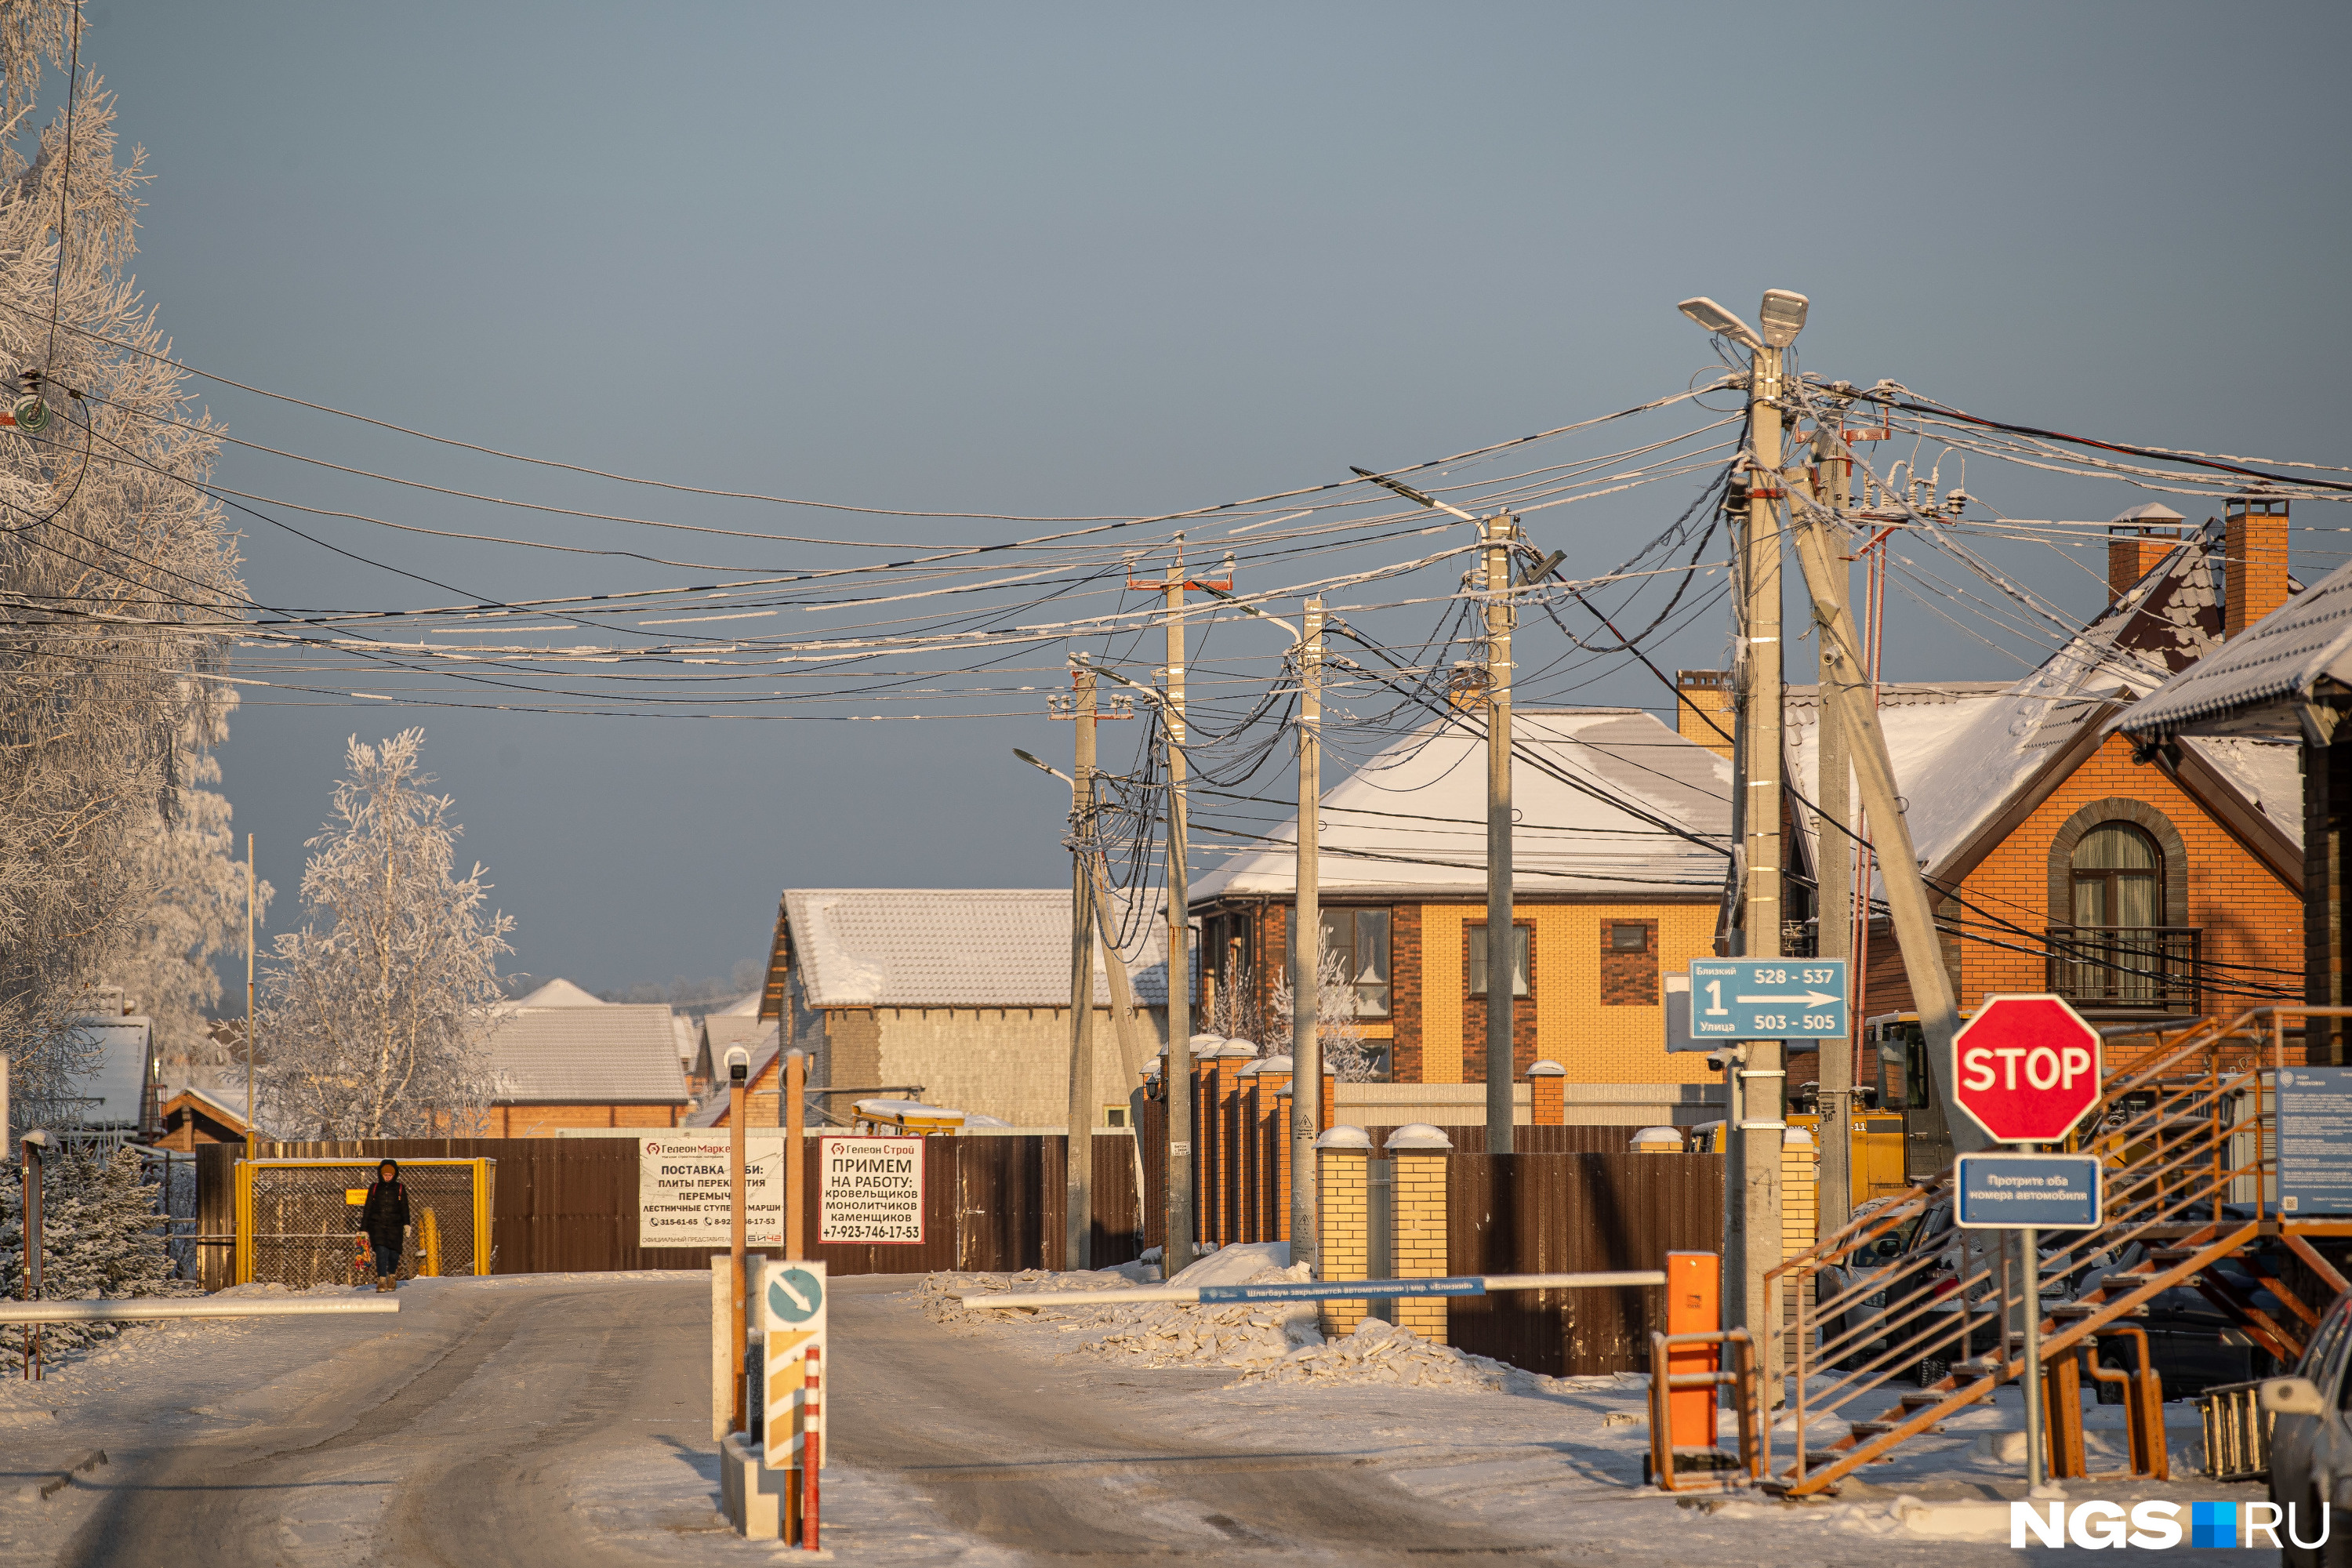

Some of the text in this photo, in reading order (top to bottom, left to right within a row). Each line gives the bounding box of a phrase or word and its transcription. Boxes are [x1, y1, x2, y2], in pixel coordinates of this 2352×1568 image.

[1696, 967, 1737, 975] Близкий
[1755, 969, 1787, 984] 528
[1803, 969, 1835, 984] 537
[1704, 979, 1729, 1016] 1
[1700, 1021, 1736, 1032] Улица
[1754, 1015, 1787, 1029] 503
[1803, 1015, 1835, 1029] 505
[1962, 1047, 2091, 1091] STOP
[1823, 1113, 1833, 1123] 10
[662, 1145, 731, 1154] ГелеонМарке
[847, 1145, 915, 1156] Гелеон Строй
[662, 1165, 724, 1175] ПОСТАВКА
[833, 1159, 912, 1173] ПРИМЕМ
[658, 1179, 765, 1188] ПЛИТЫ ПЕРЕКТИЯ
[831, 1176, 913, 1188] НА РАБОТУ:
[1987, 1174, 2068, 1189] Протрите оба
[678, 1192, 731, 1201] ПЕРЕМЫЧ
[825, 1189, 918, 1200] кровельщиков
[1969, 1189, 2088, 1202] номера автомобиля
[826, 1202, 917, 1210] монолитчиков
[830, 1213, 912, 1224] каменщиков
[823, 1225, 920, 1238] +7-923-746-17-53
[1247, 1288, 1289, 1298] Шлагбаум
[1290, 1287, 1341, 1297] закрывается
[1343, 1285, 1404, 1294] автоматически
[1410, 1284, 1428, 1293] мкр.
[1430, 1282, 1474, 1291] «Близкий»
